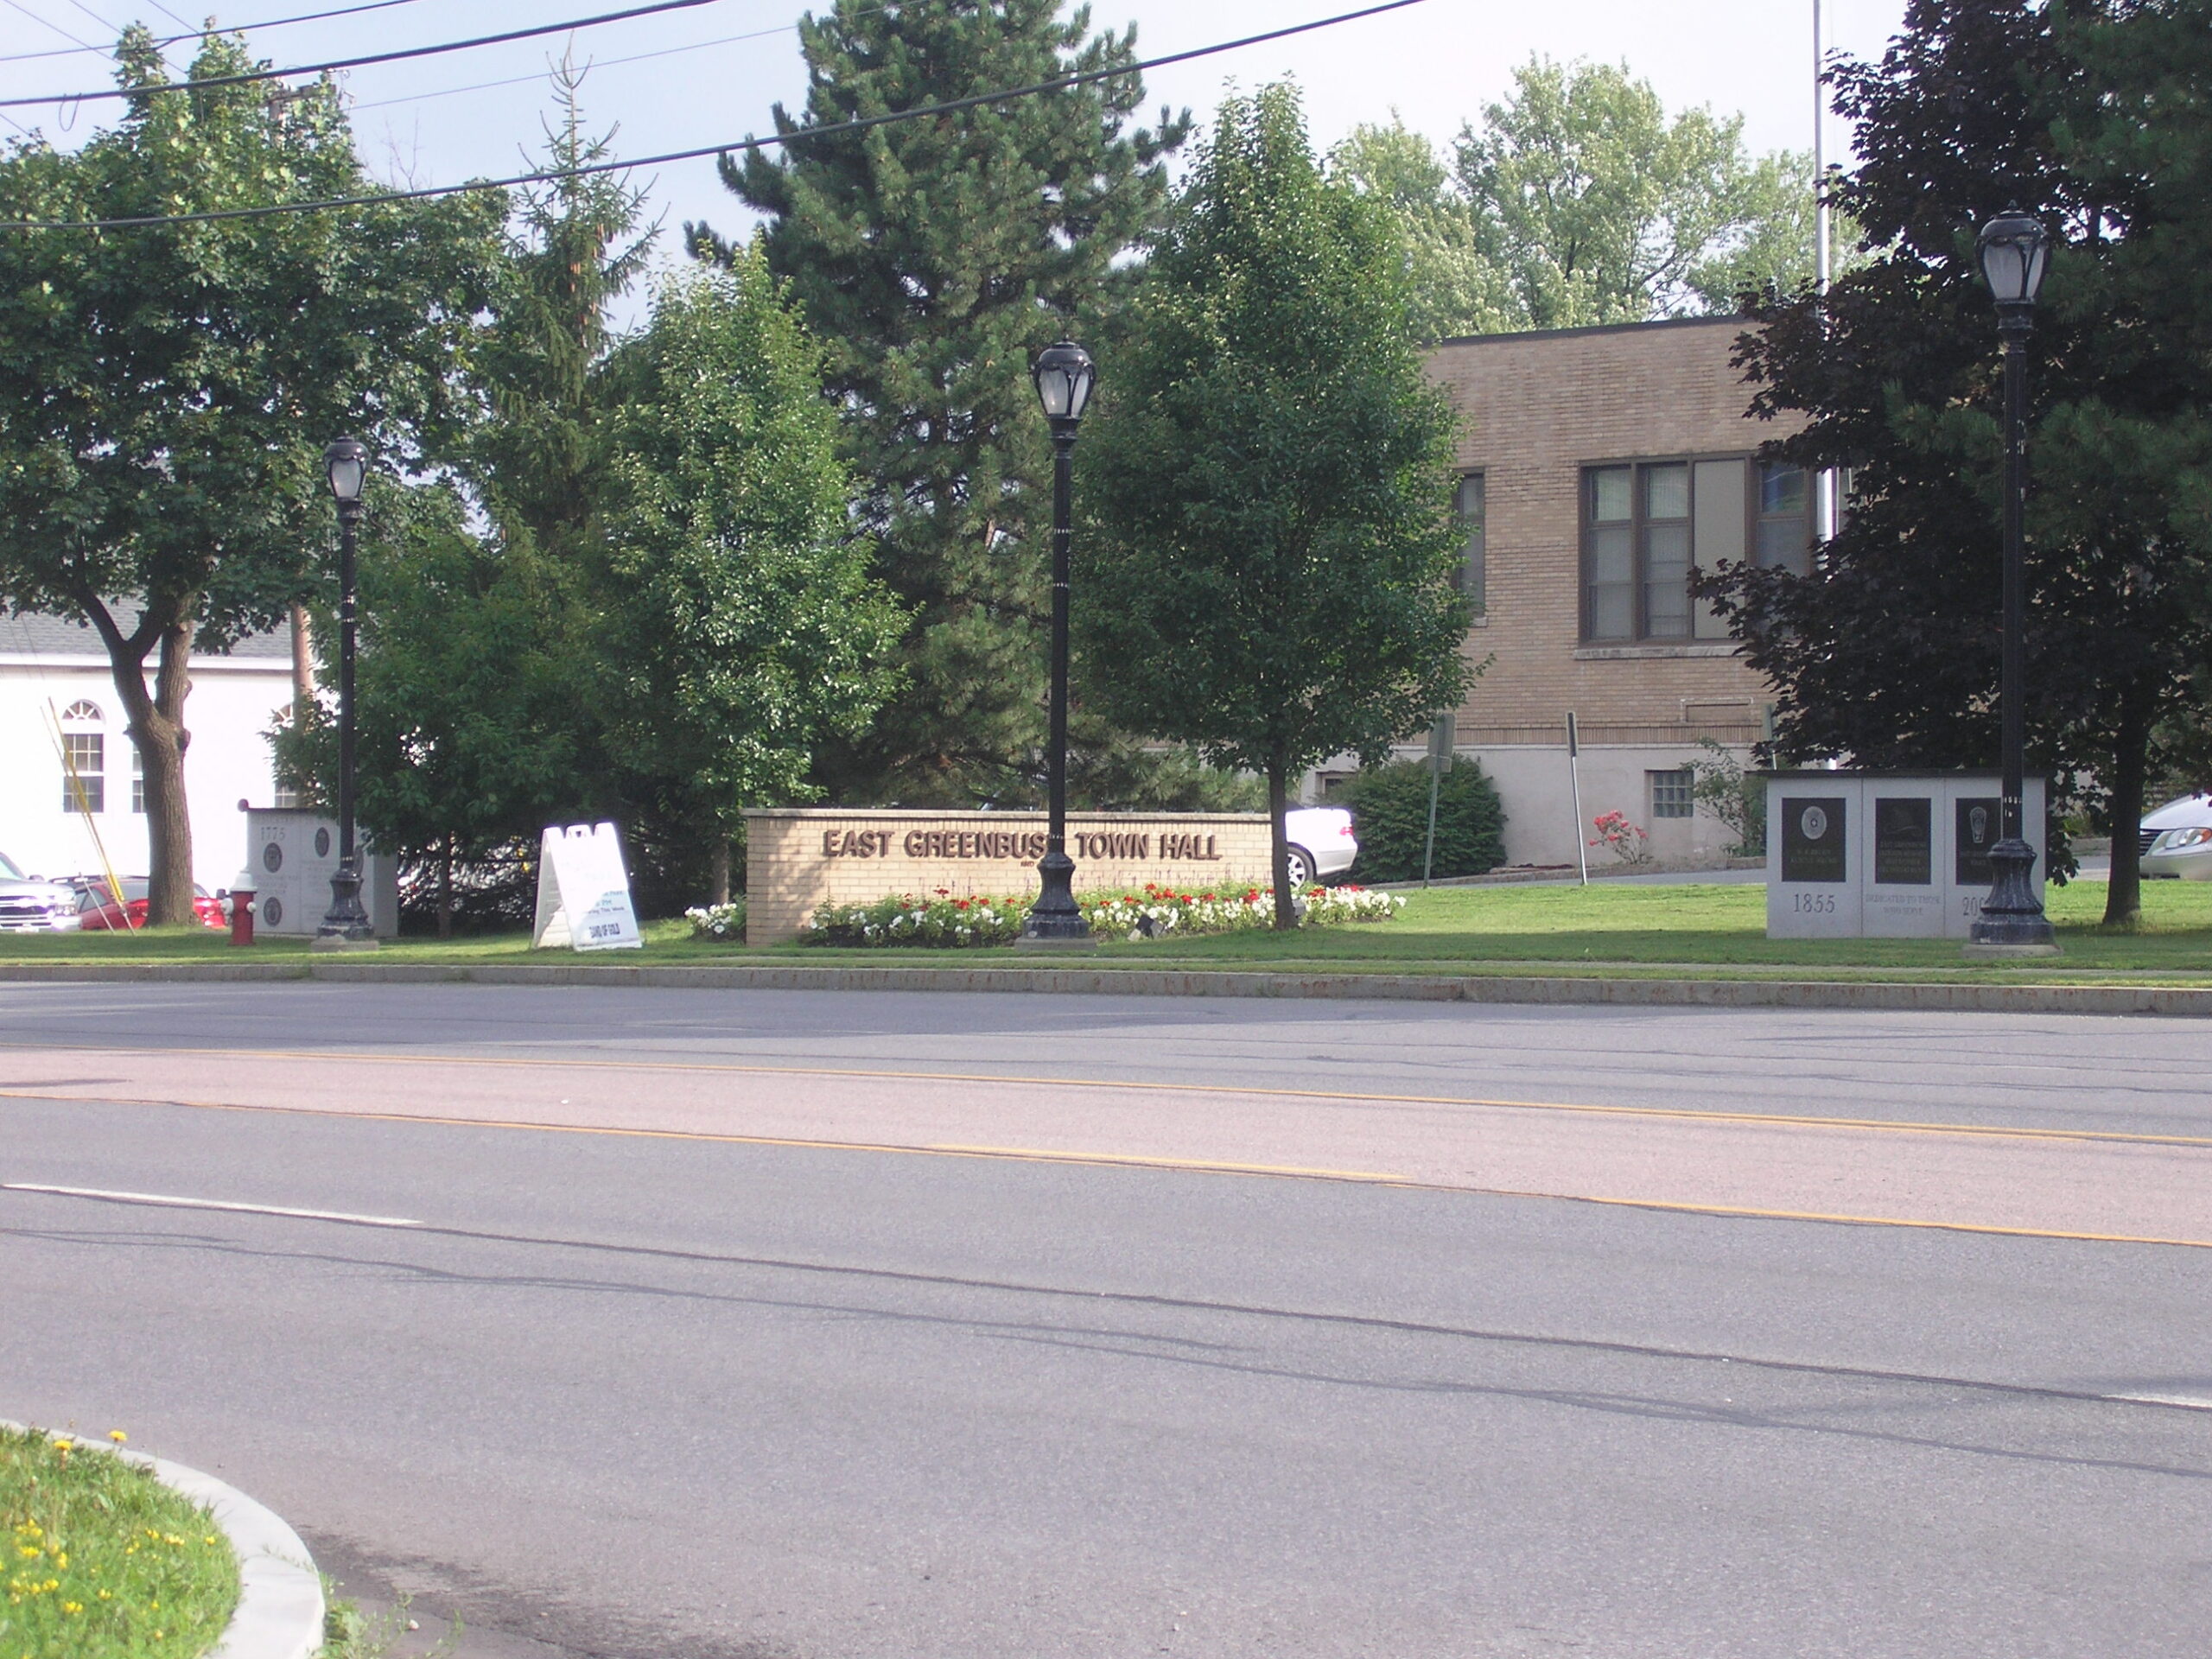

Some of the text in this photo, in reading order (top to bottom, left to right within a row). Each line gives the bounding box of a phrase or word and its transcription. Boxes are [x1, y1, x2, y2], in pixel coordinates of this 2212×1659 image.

[823, 830, 1224, 861] EAST GREENBUS TOWN HALL
[1793, 893, 1835, 913] 1855
